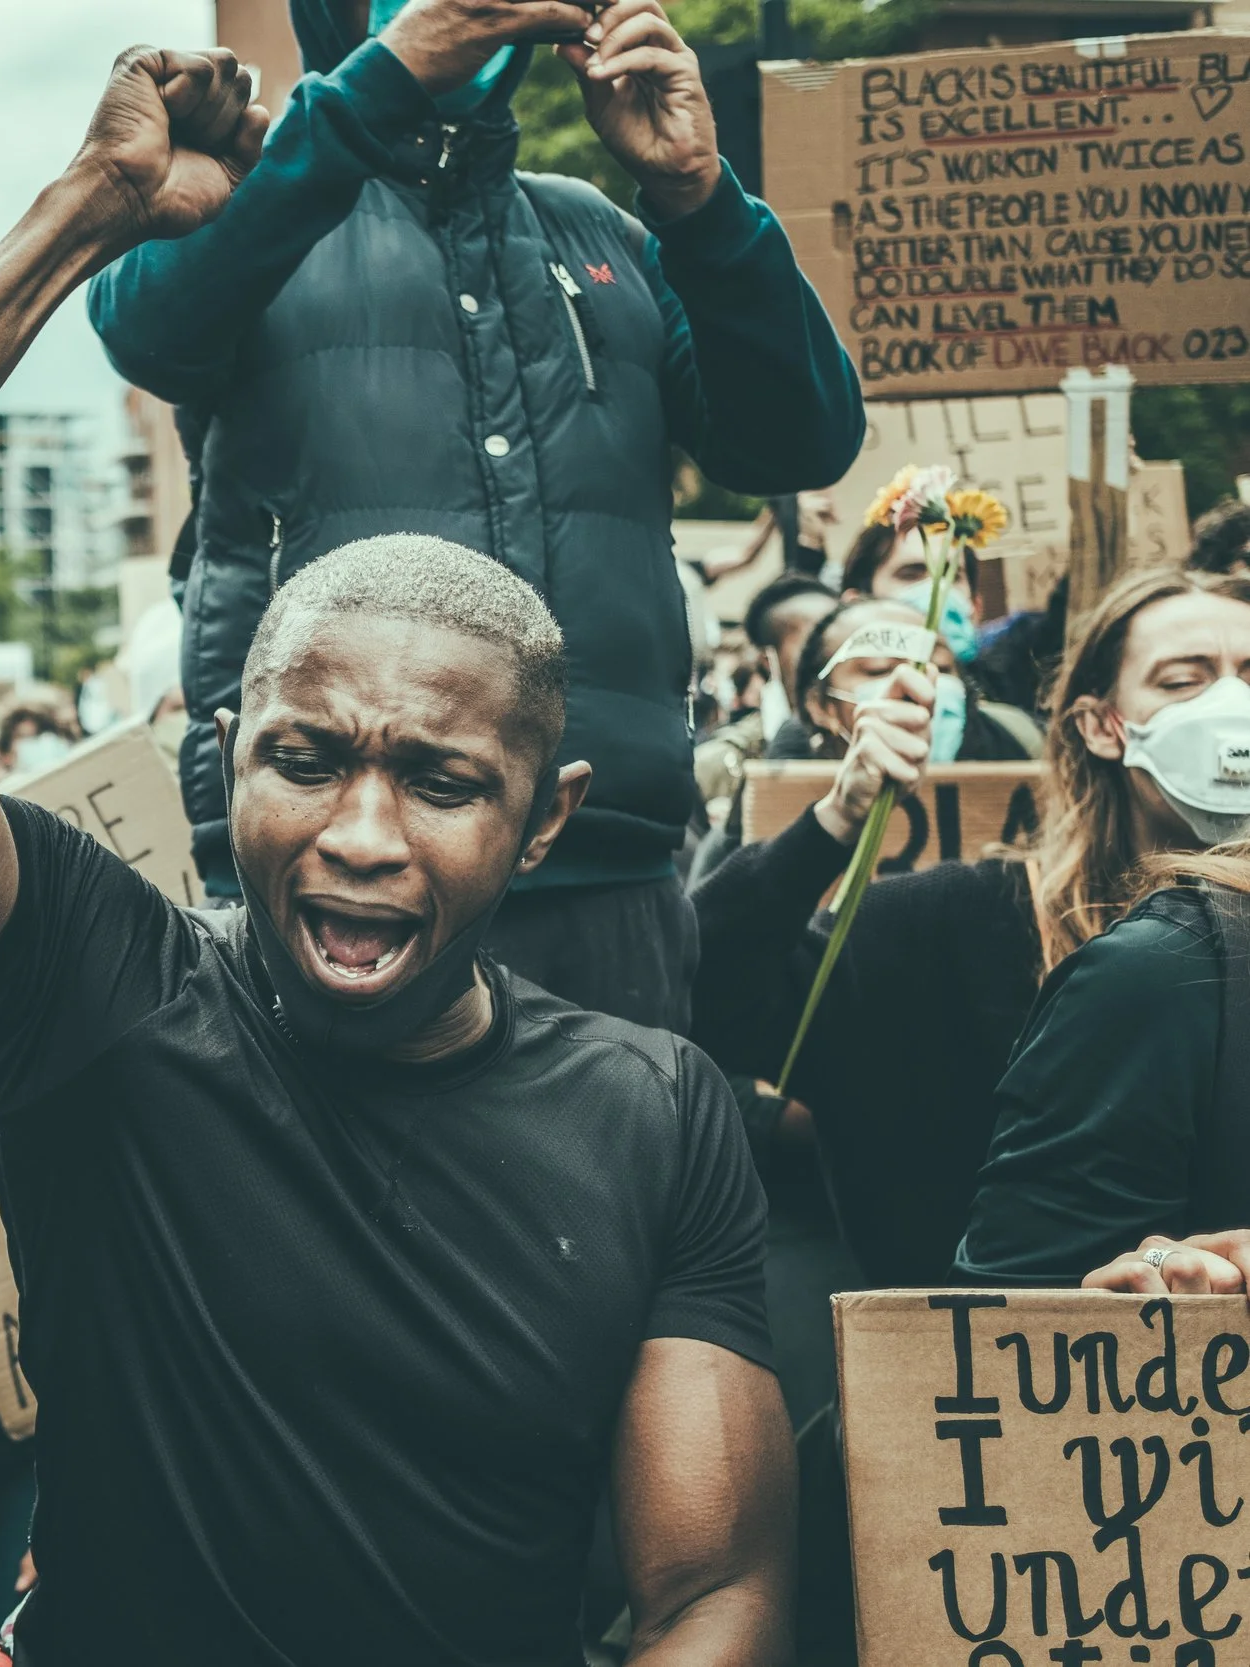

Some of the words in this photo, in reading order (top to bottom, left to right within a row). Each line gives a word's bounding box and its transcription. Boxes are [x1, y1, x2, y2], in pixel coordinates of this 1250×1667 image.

[857, 111, 905, 145] IS
[1075, 137, 1195, 174] TWICE
[1197, 132, 1245, 165] AS
[855, 195, 904, 233] AS
[963, 190, 1070, 229] PEOPLE
[1076, 184, 1129, 221] YOU
[1140, 182, 1231, 219] KNOW
[853, 235, 957, 273] BETTER
[1045, 225, 1132, 257] CAUSE
[1138, 222, 1198, 254] YOU
[1202, 219, 1250, 252] NE
[853, 269, 903, 301] DO
[905, 264, 1018, 297] DOUBLE
[1173, 252, 1215, 284] DO
[851, 303, 920, 333] CAN
[933, 302, 1019, 333] LEVEL
[1022, 292, 1120, 327] THEM
[860, 335, 944, 381] BOOK
[946, 338, 988, 371] OF
[993, 332, 1070, 370] DAVE
[927, 1293, 1008, 1414] I
[934, 1418, 1009, 1527] I
[1062, 1415, 1250, 1527] wi
[927, 1520, 1250, 1643] unde
